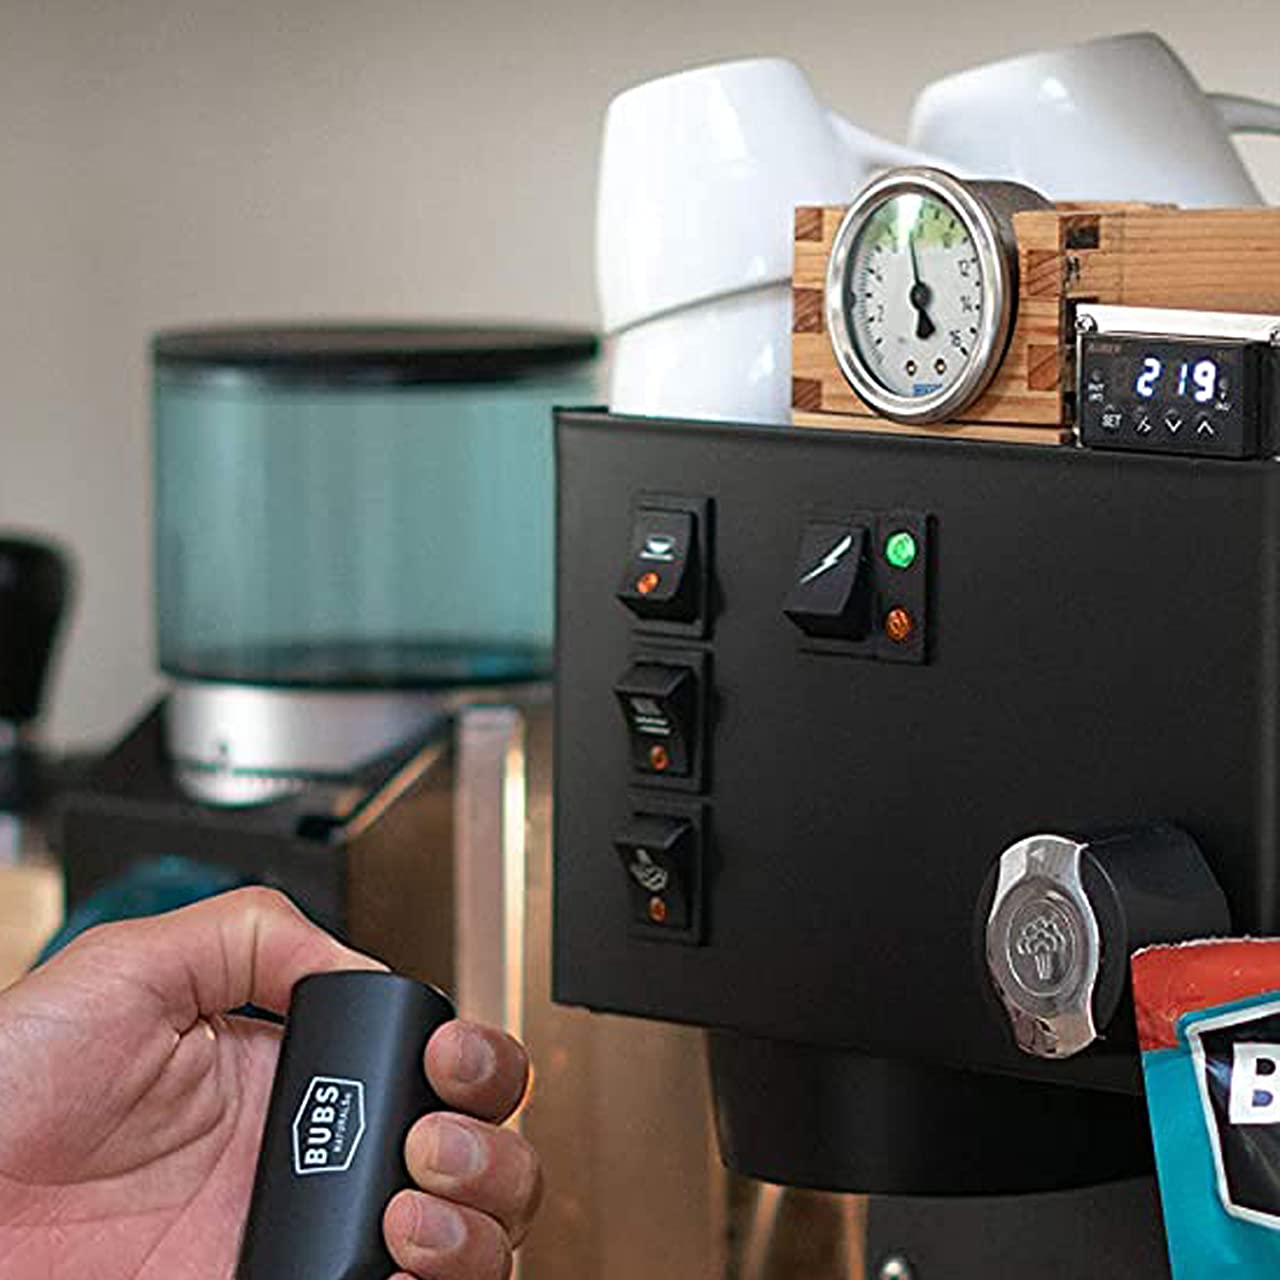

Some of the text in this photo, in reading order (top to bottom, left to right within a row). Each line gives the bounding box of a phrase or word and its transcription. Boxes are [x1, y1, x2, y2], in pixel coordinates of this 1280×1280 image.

[1137, 357, 1216, 402] 219
[1102, 414, 1122, 428] SET
[304, 1086, 339, 1164] BUBS
